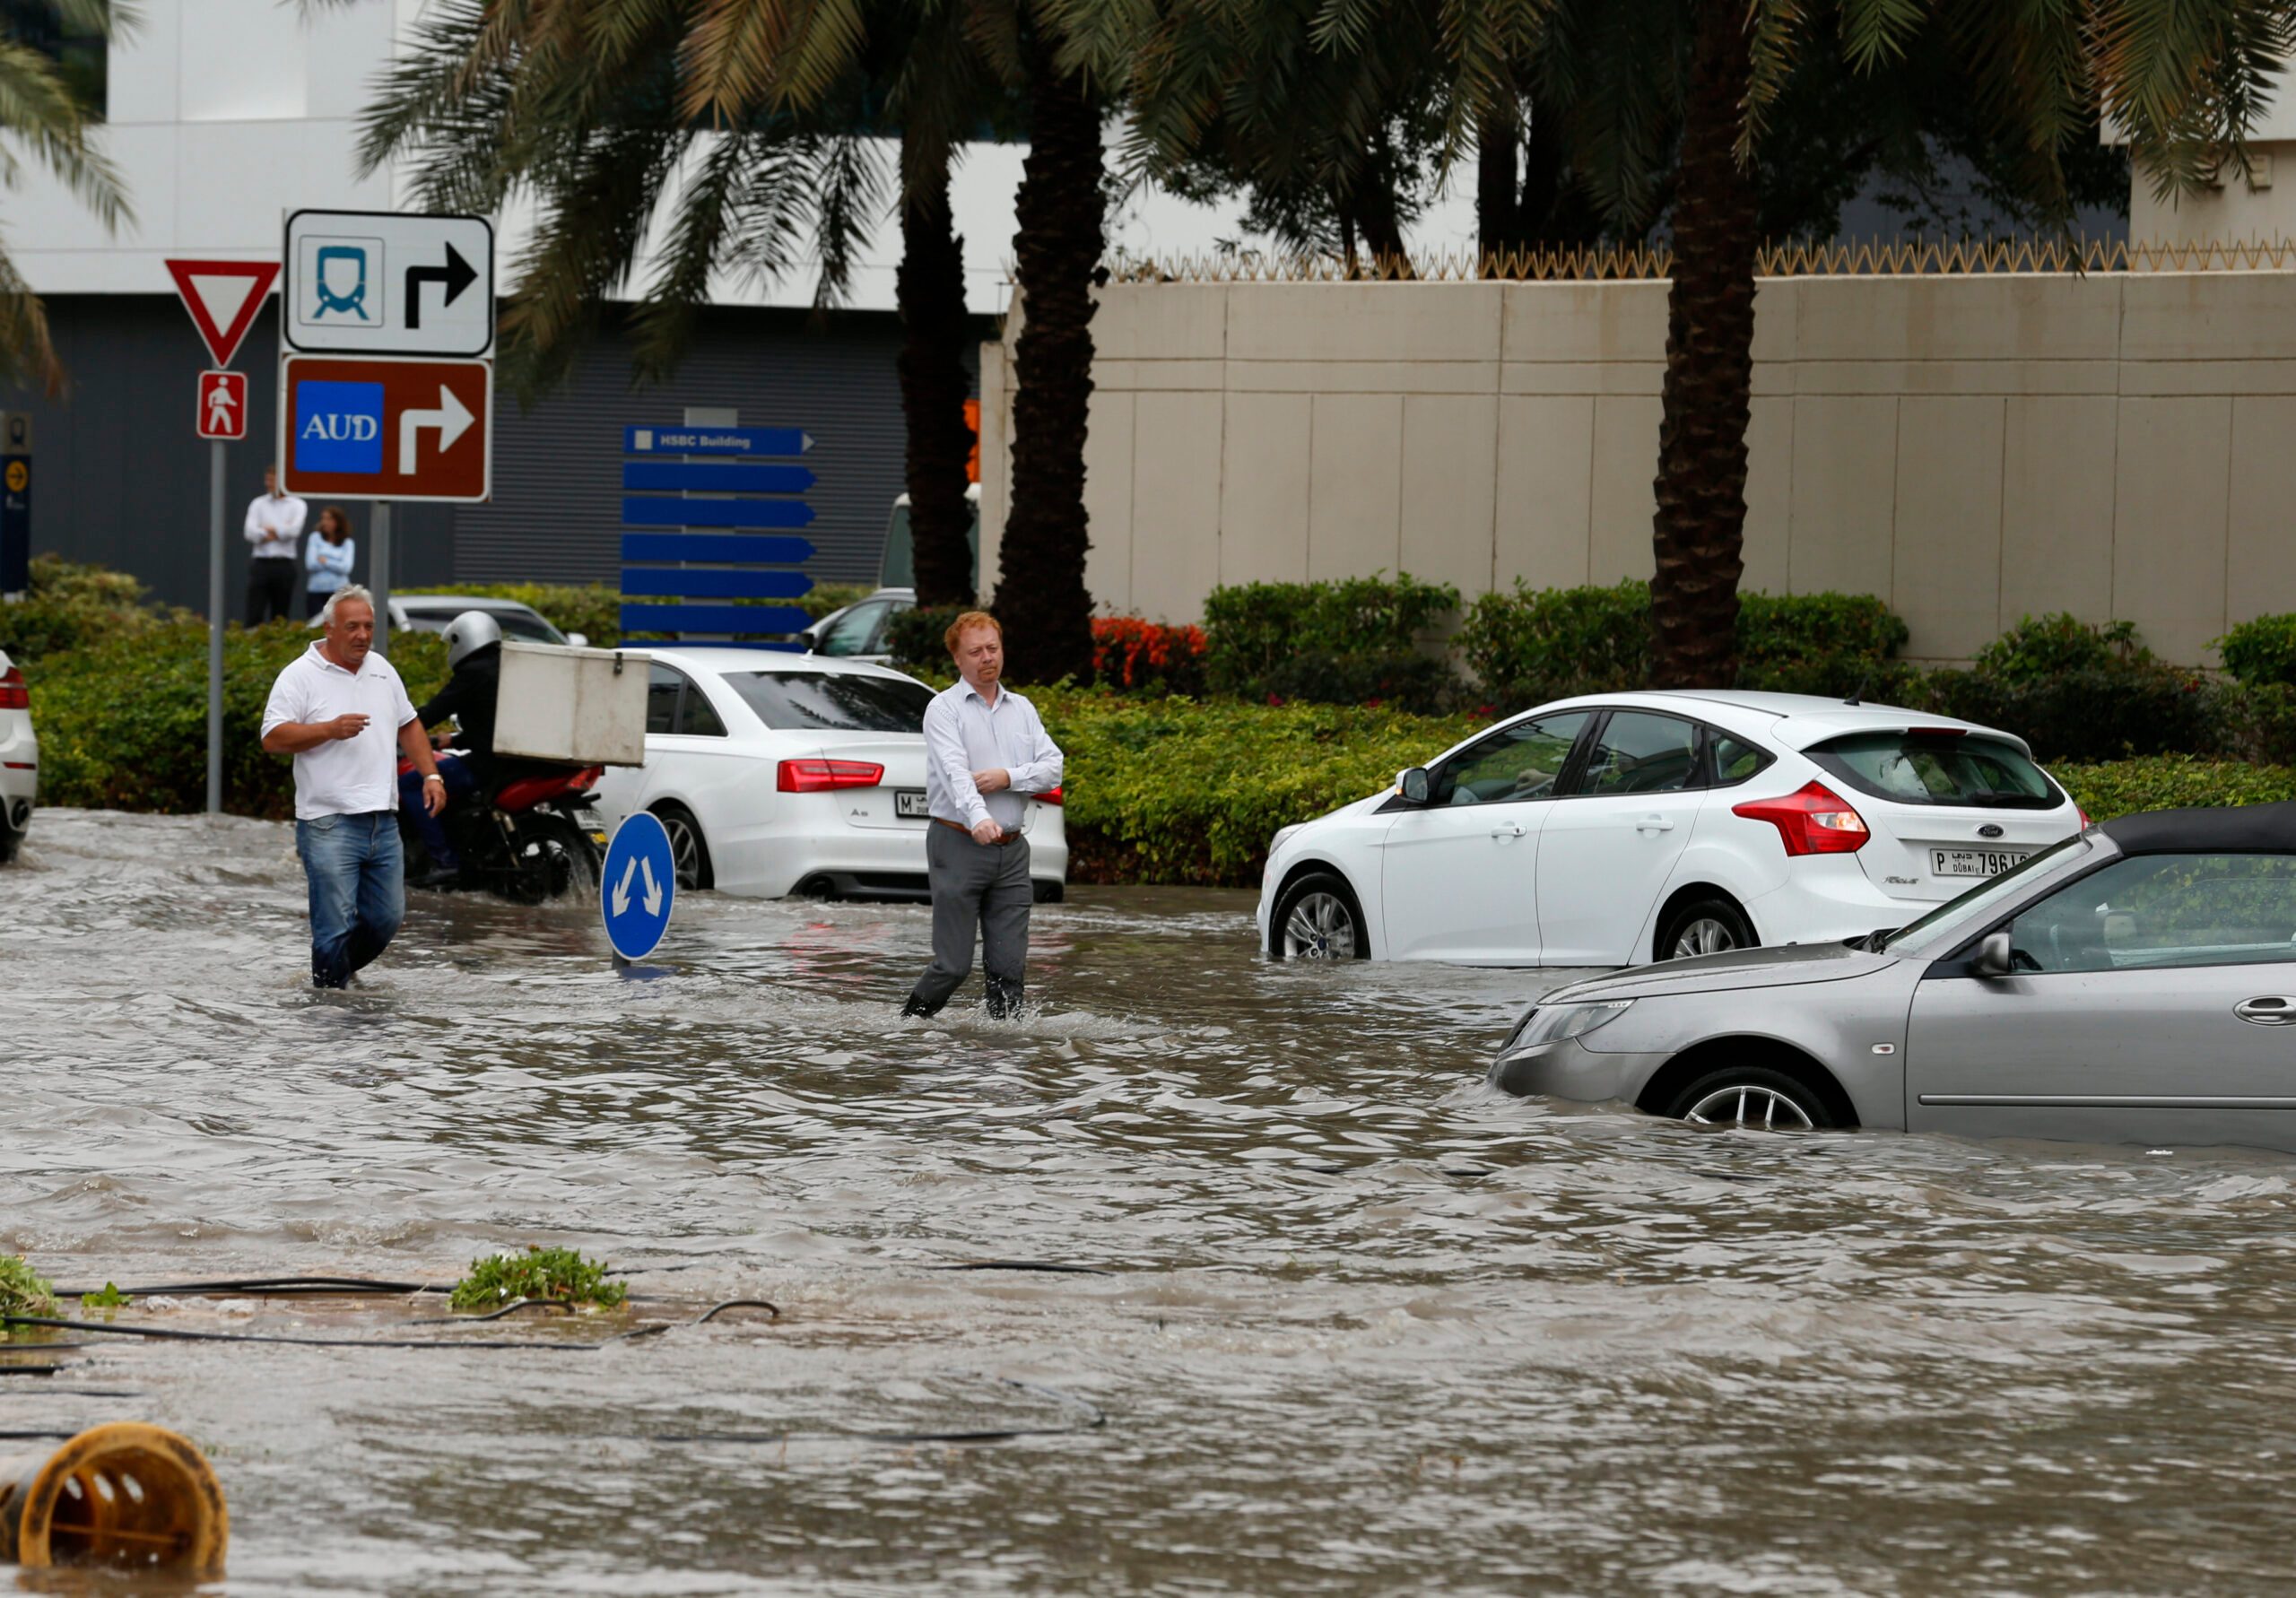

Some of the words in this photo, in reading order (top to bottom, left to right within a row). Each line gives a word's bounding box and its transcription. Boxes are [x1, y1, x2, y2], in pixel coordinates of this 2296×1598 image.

[301, 413, 378, 441] AUD
[660, 436, 697, 447] HSBC
[700, 436, 751, 449] Building
[900, 795, 912, 812] M
[1936, 853, 1945, 872] P
